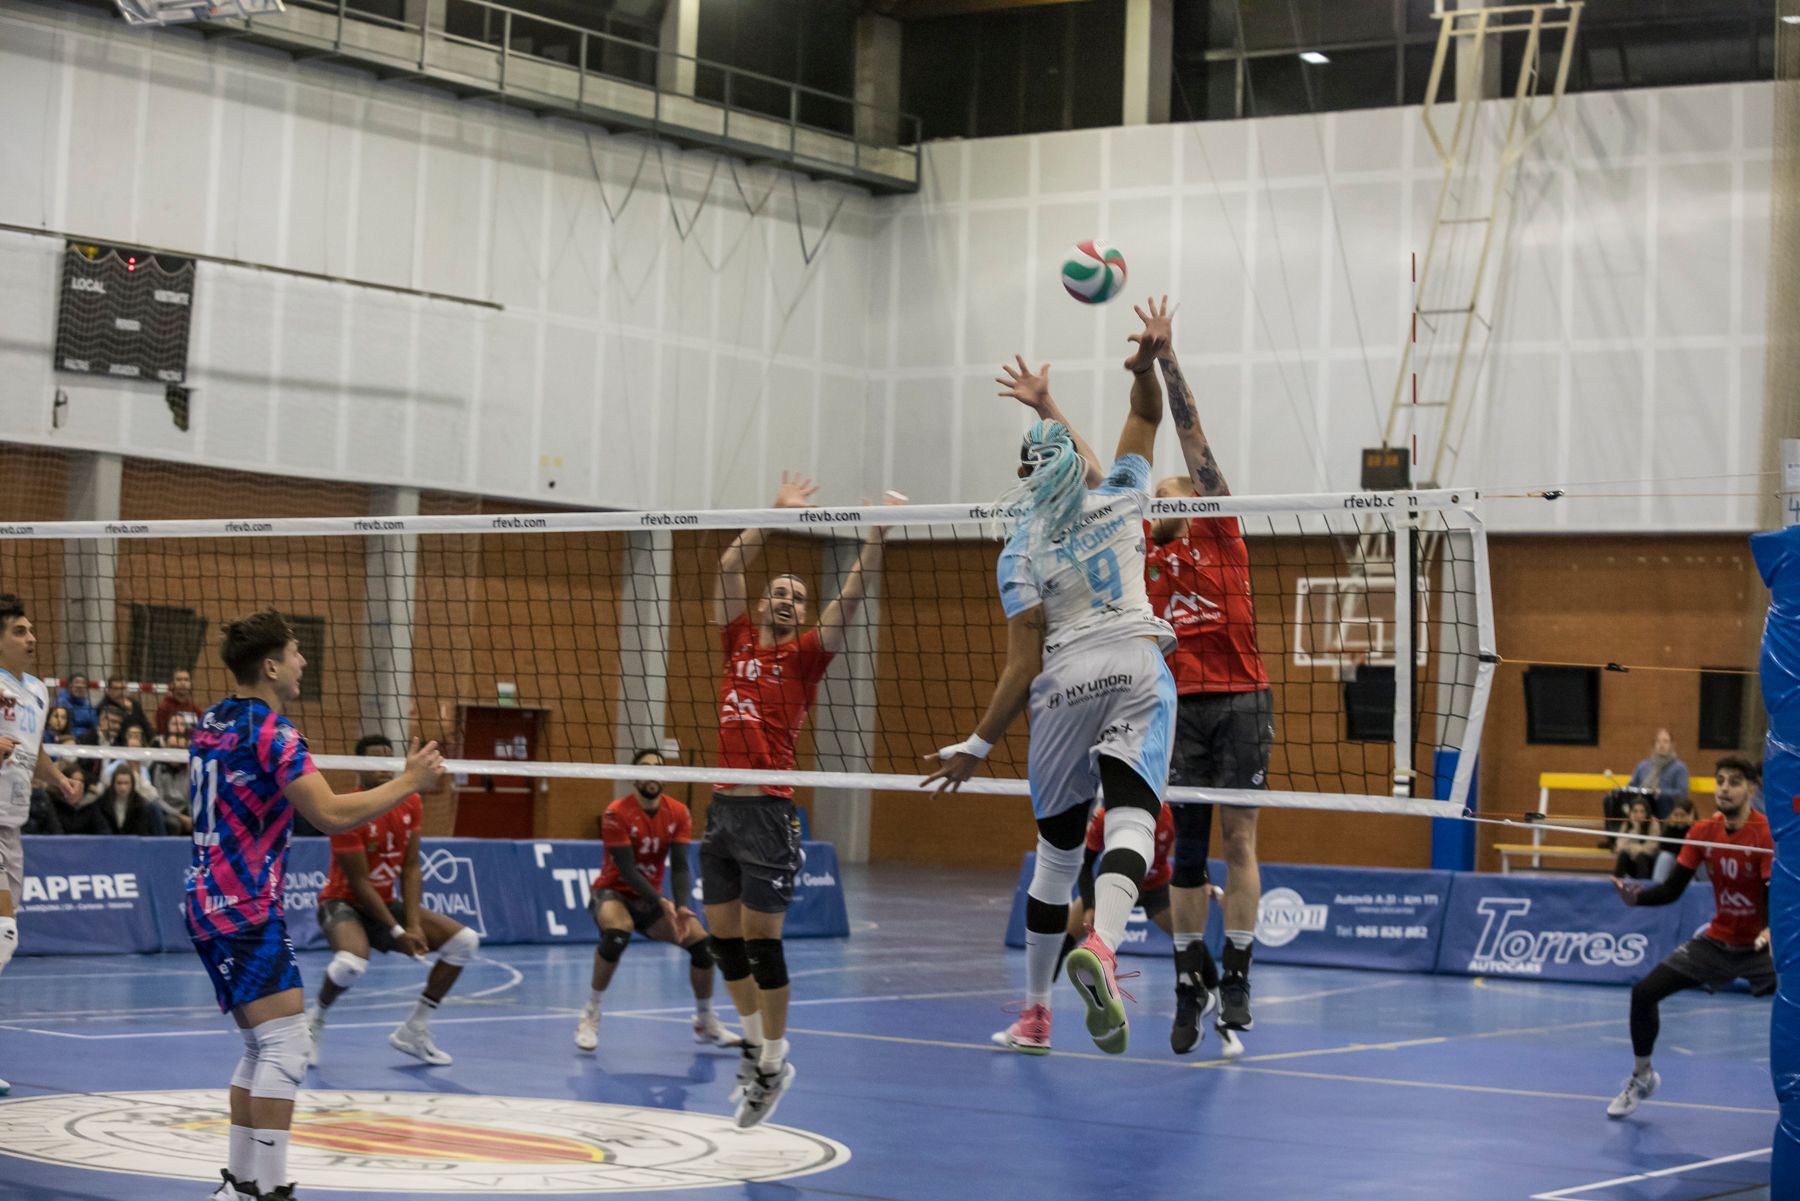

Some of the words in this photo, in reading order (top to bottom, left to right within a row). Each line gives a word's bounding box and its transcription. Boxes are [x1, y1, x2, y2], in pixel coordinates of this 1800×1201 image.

[71, 277, 107, 294] LOCAL
[1150, 501, 1221, 514] rfevb.com
[1343, 494, 1418, 508] rfevb.cm
[492, 516, 546, 529] rfevb.com
[641, 512, 698, 526] rfevb.com
[799, 509, 861, 523] rfevb.com
[105, 523, 149, 535] rfevb.com
[225, 521, 273, 533] rfevb.com
[354, 519, 404, 531] rfevb.com
[1086, 547, 1123, 609] 9
[1065, 674, 1133, 699] HYUNDAI
[639, 836, 660, 855] 21
[1720, 857, 1738, 878] 10
[22, 873, 139, 902] APFRE
[1473, 897, 1649, 967] Torres
[1467, 960, 1542, 975] AUTOCARS
